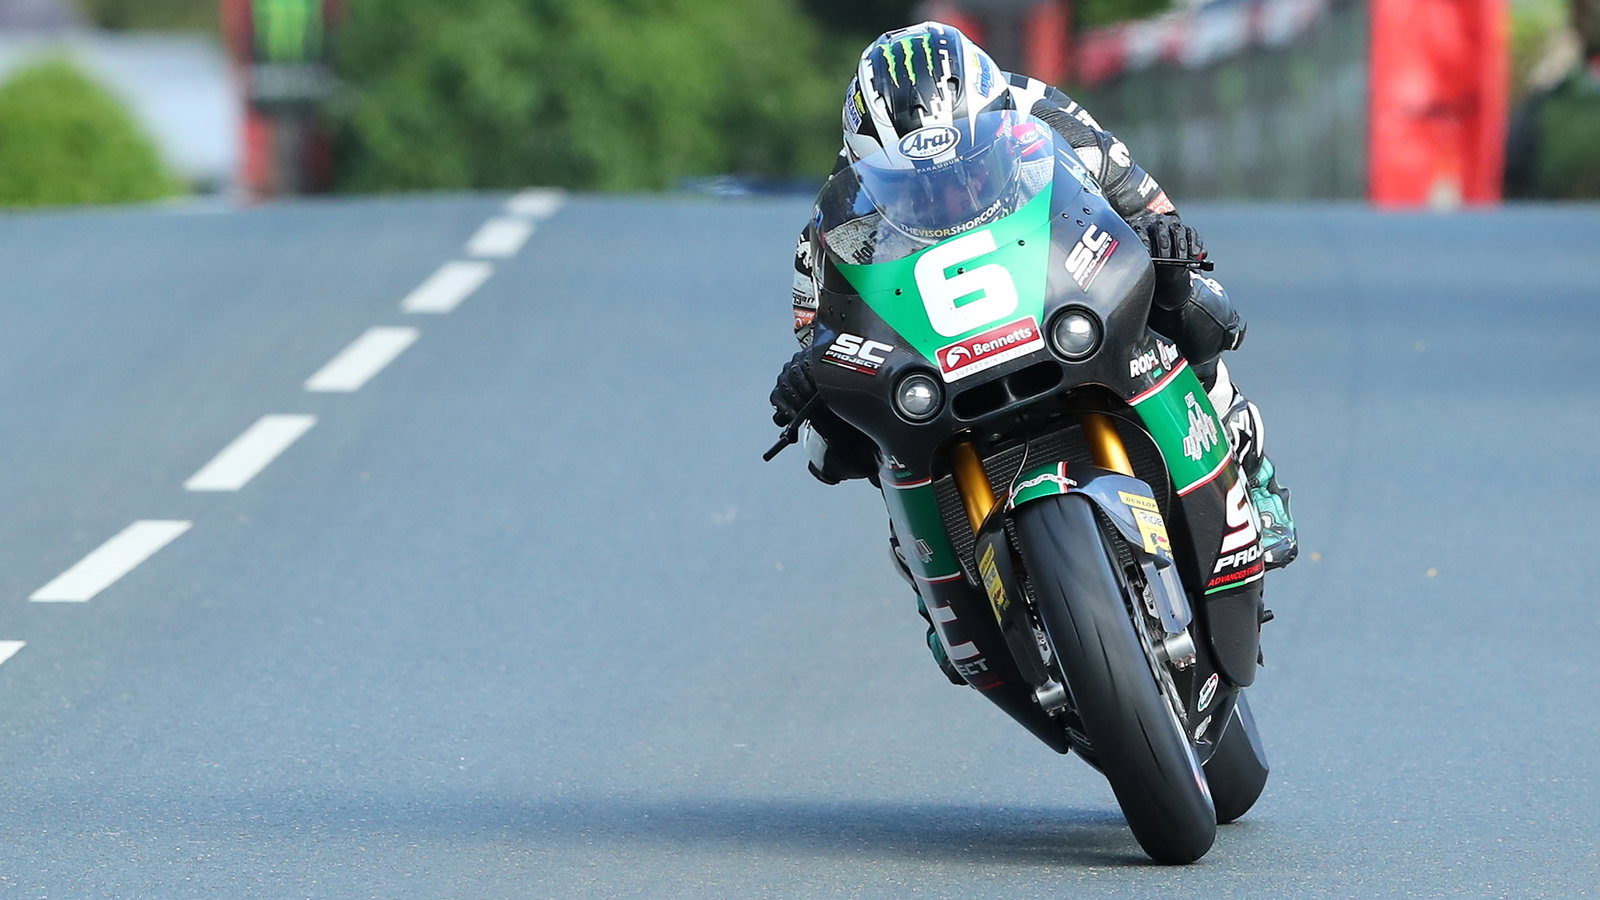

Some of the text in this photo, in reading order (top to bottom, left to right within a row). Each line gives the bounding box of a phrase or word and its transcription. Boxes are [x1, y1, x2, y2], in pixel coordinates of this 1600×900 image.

[904, 129, 952, 153] Arai
[916, 155, 964, 173] PARAMOUNT
[900, 201, 1002, 238] THEVISORSHOP.COM
[1064, 224, 1110, 282] SC
[1077, 234, 1113, 287] PROJECT
[914, 229, 1019, 338] 6
[829, 332, 895, 365] SC
[972, 326, 1033, 357] Bennetts
[824, 350, 884, 370] PROJECT
[1124, 497, 1158, 509] DUNLOP
